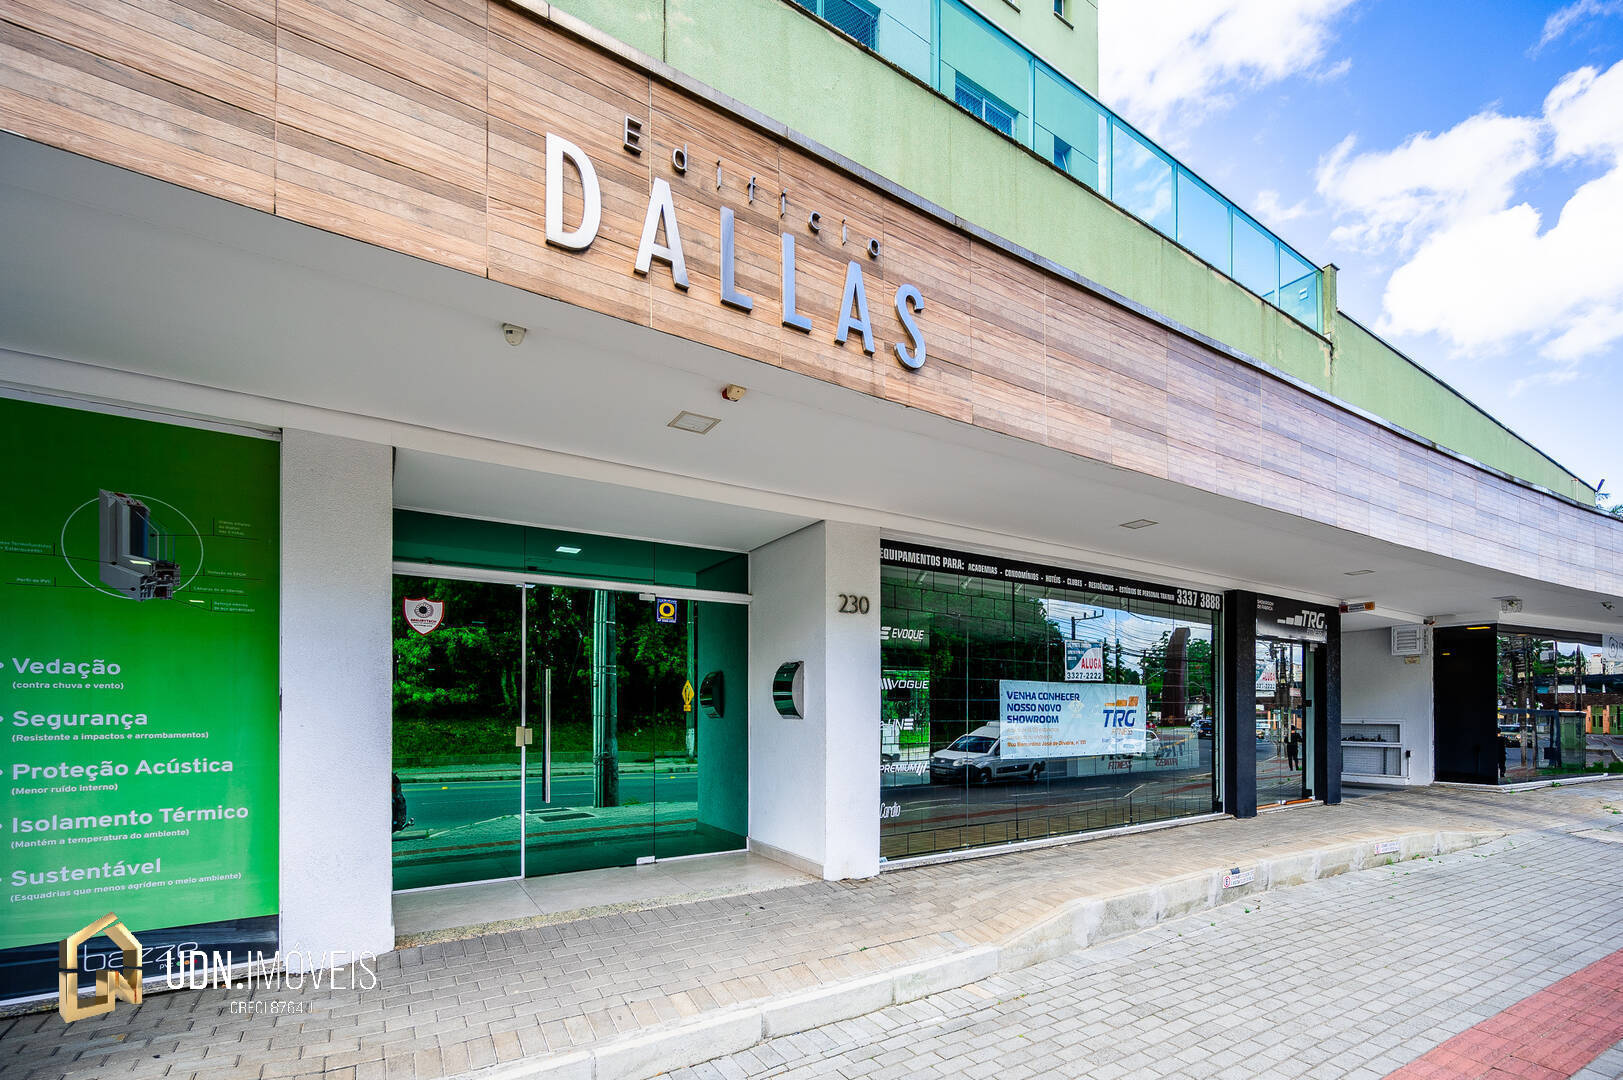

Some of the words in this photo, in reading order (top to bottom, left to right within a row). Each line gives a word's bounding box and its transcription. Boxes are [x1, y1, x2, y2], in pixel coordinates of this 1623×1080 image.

[546, 132, 927, 371] DALLAS
[880, 547, 941, 567] EQUIPAMENTOS
[942, 556, 965, 570] PARA:
[967, 563, 998, 575] ACADEMIAS
[1176, 588, 1198, 607] 3337
[1200, 592, 1221, 610] 3888
[838, 594, 870, 615] 230
[1301, 609, 1326, 629] TRG
[891, 628, 925, 640] EVOQUE
[12, 657, 121, 679] Vedação
[1081, 657, 1102, 669] ALUGA
[891, 679, 930, 689] VOGUE
[1066, 671, 1102, 680] 3327-2222
[12, 681, 50, 689] (contra
[52, 681, 83, 689] chuva
[93, 682, 124, 690] vento)
[1006, 690, 1037, 700] VENHA
[1038, 692, 1080, 701] CONHECER
[1006, 703, 1037, 712] NOSSO
[1038, 703, 1062, 712] NOVO
[12, 711, 148, 730] Segurança
[1006, 715, 1059, 724] SHOWROOM
[1103, 709, 1137, 728] TRG
[11, 733, 71, 742] (Resistente
[81, 732, 125, 741] impactos
[134, 731, 209, 740] arrombamentos)
[12, 760, 129, 781] Proteção
[135, 757, 233, 776] Acústica
[11, 786, 48, 796] (Menor
[50, 784, 77, 793] ruído
[79, 783, 118, 792] interno)
[12, 809, 153, 834] Isolamento
[159, 805, 249, 823] Térmico
[10, 838, 57, 849] (Mantém
[68, 833, 128, 845] temperatura
[130, 832, 142, 840] do
[143, 828, 190, 839] ambiente)
[11, 858, 161, 887] Sustentável
[10, 888, 71, 903] (Esquadrias
[73, 886, 92, 896] que
[94, 883, 126, 893] menos
[199, 872, 242, 883] ambiente)
